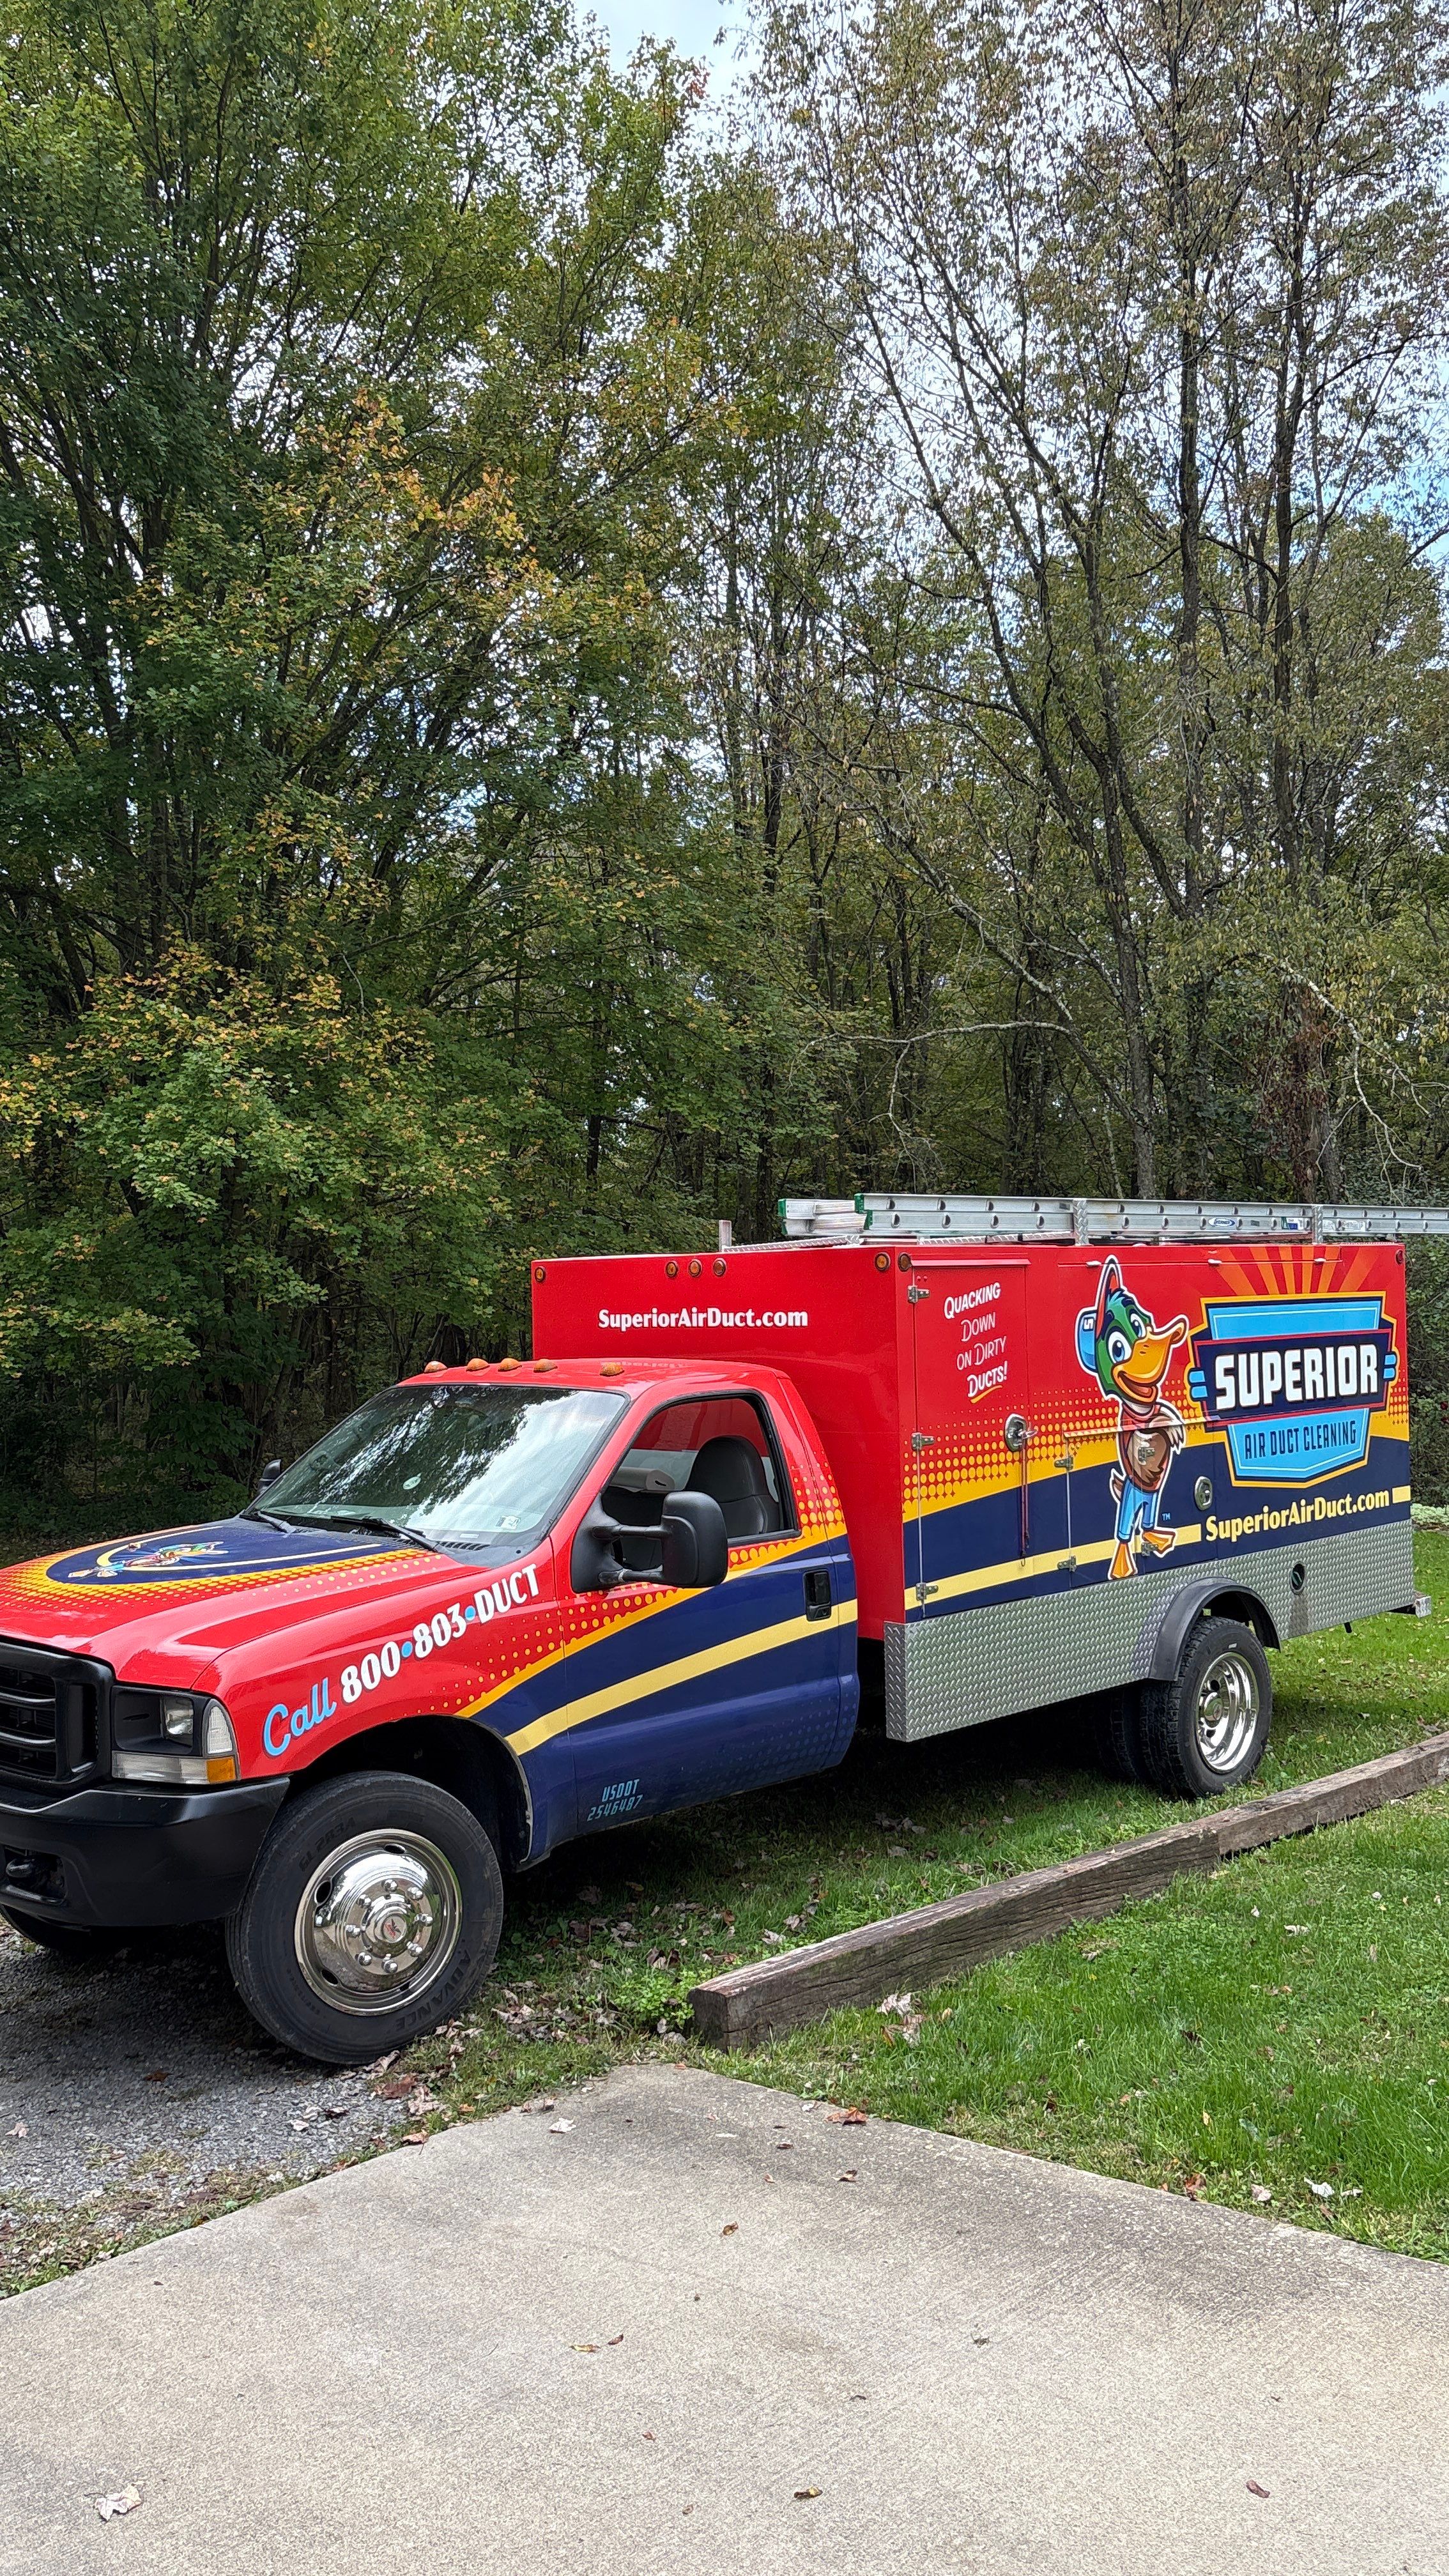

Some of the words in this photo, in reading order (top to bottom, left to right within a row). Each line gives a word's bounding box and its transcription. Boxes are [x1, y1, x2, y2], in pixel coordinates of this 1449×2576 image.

[598, 1307, 809, 1331] SuperiorAirDuct.com
[944, 1282, 1002, 1320] QUACKING
[960, 1312, 996, 1342] DOWN
[956, 1349, 972, 1370] ON
[974, 1335, 1007, 1365] DIRTY
[967, 1360, 1008, 1398] DUCTS!
[1215, 1344, 1378, 1410] SUPERIOR
[1245, 1432, 1266, 1460] AIR
[1269, 1428, 1300, 1456] DUCT
[1303, 1420, 1356, 1451] CLEANING
[1205, 1489, 1390, 1543] SuperiorAirDuct.com
[263, 1676, 337, 1757] Call
[586, 1794, 643, 1821] 2546487
[601, 1778, 640, 1802] USDOT
[394, 1949, 471, 2032] ADVANCE
